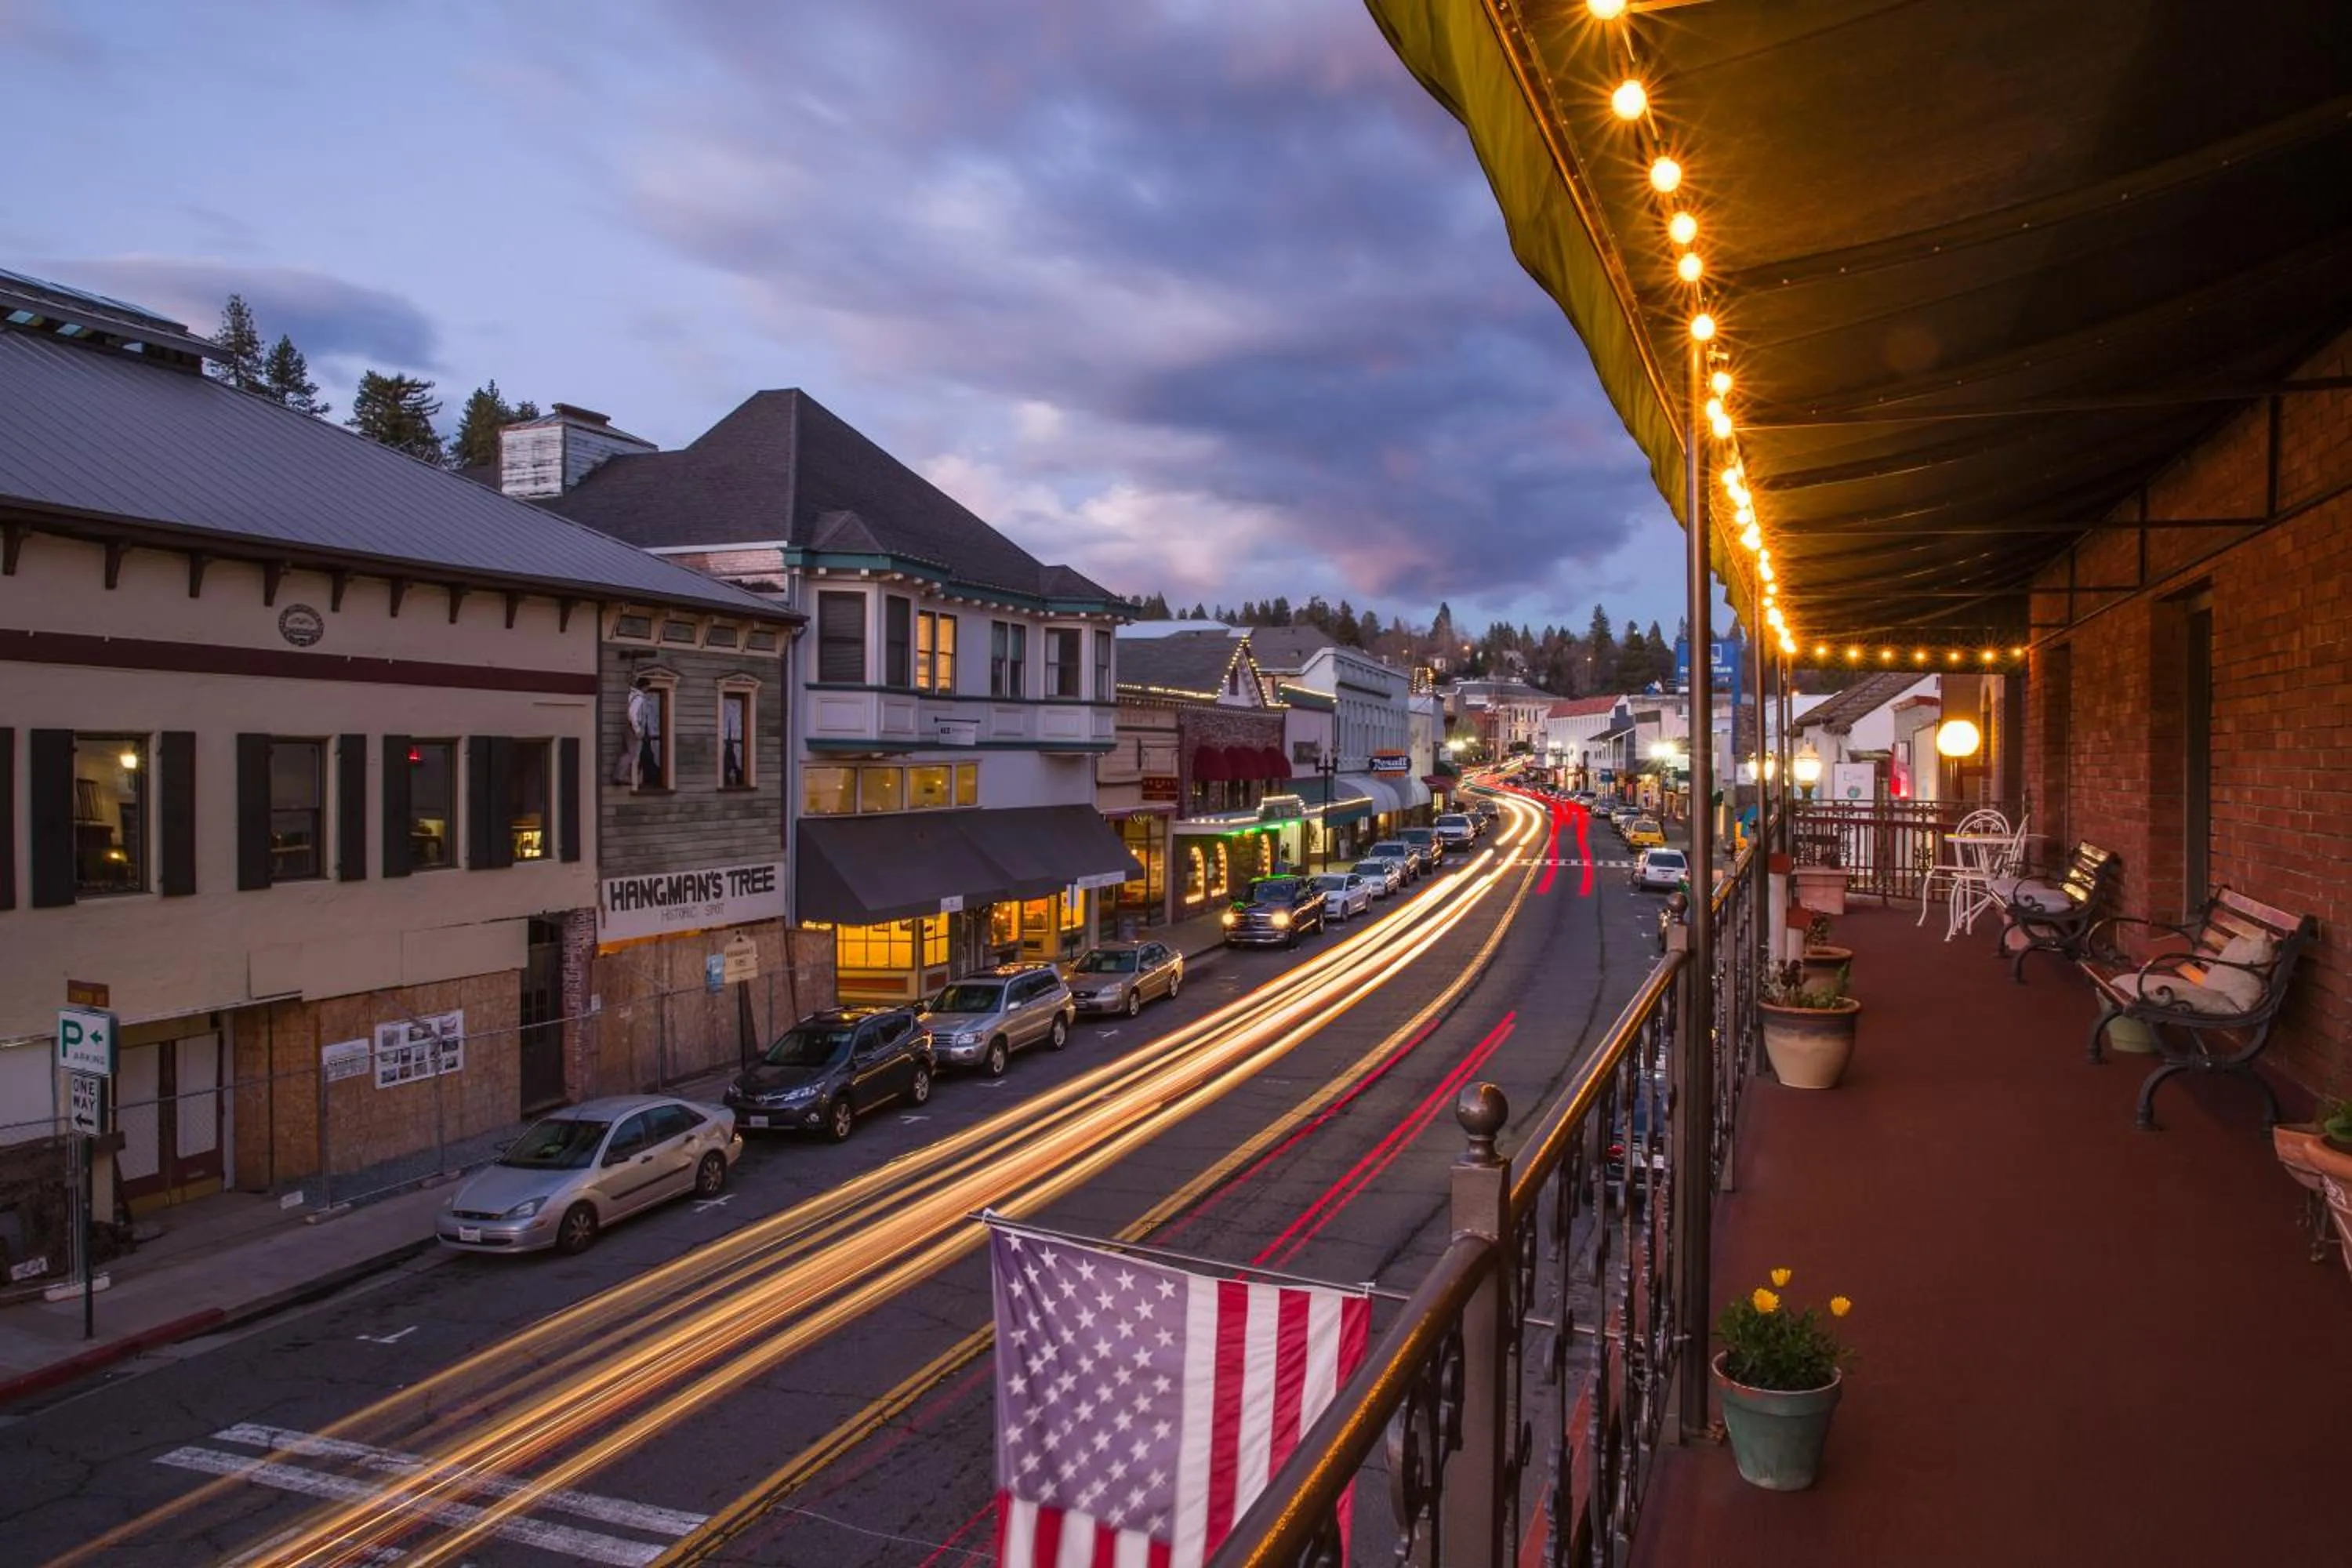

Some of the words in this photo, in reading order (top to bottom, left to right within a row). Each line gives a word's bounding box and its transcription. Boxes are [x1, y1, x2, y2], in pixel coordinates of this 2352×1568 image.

[609, 870, 724, 912] HANGMAN'S
[726, 865, 775, 898] TREE
[660, 906, 697, 922] HISTORIC
[703, 902, 724, 916] SPOT
[73, 1078, 96, 1096] ONE
[73, 1095, 96, 1112] WAY
